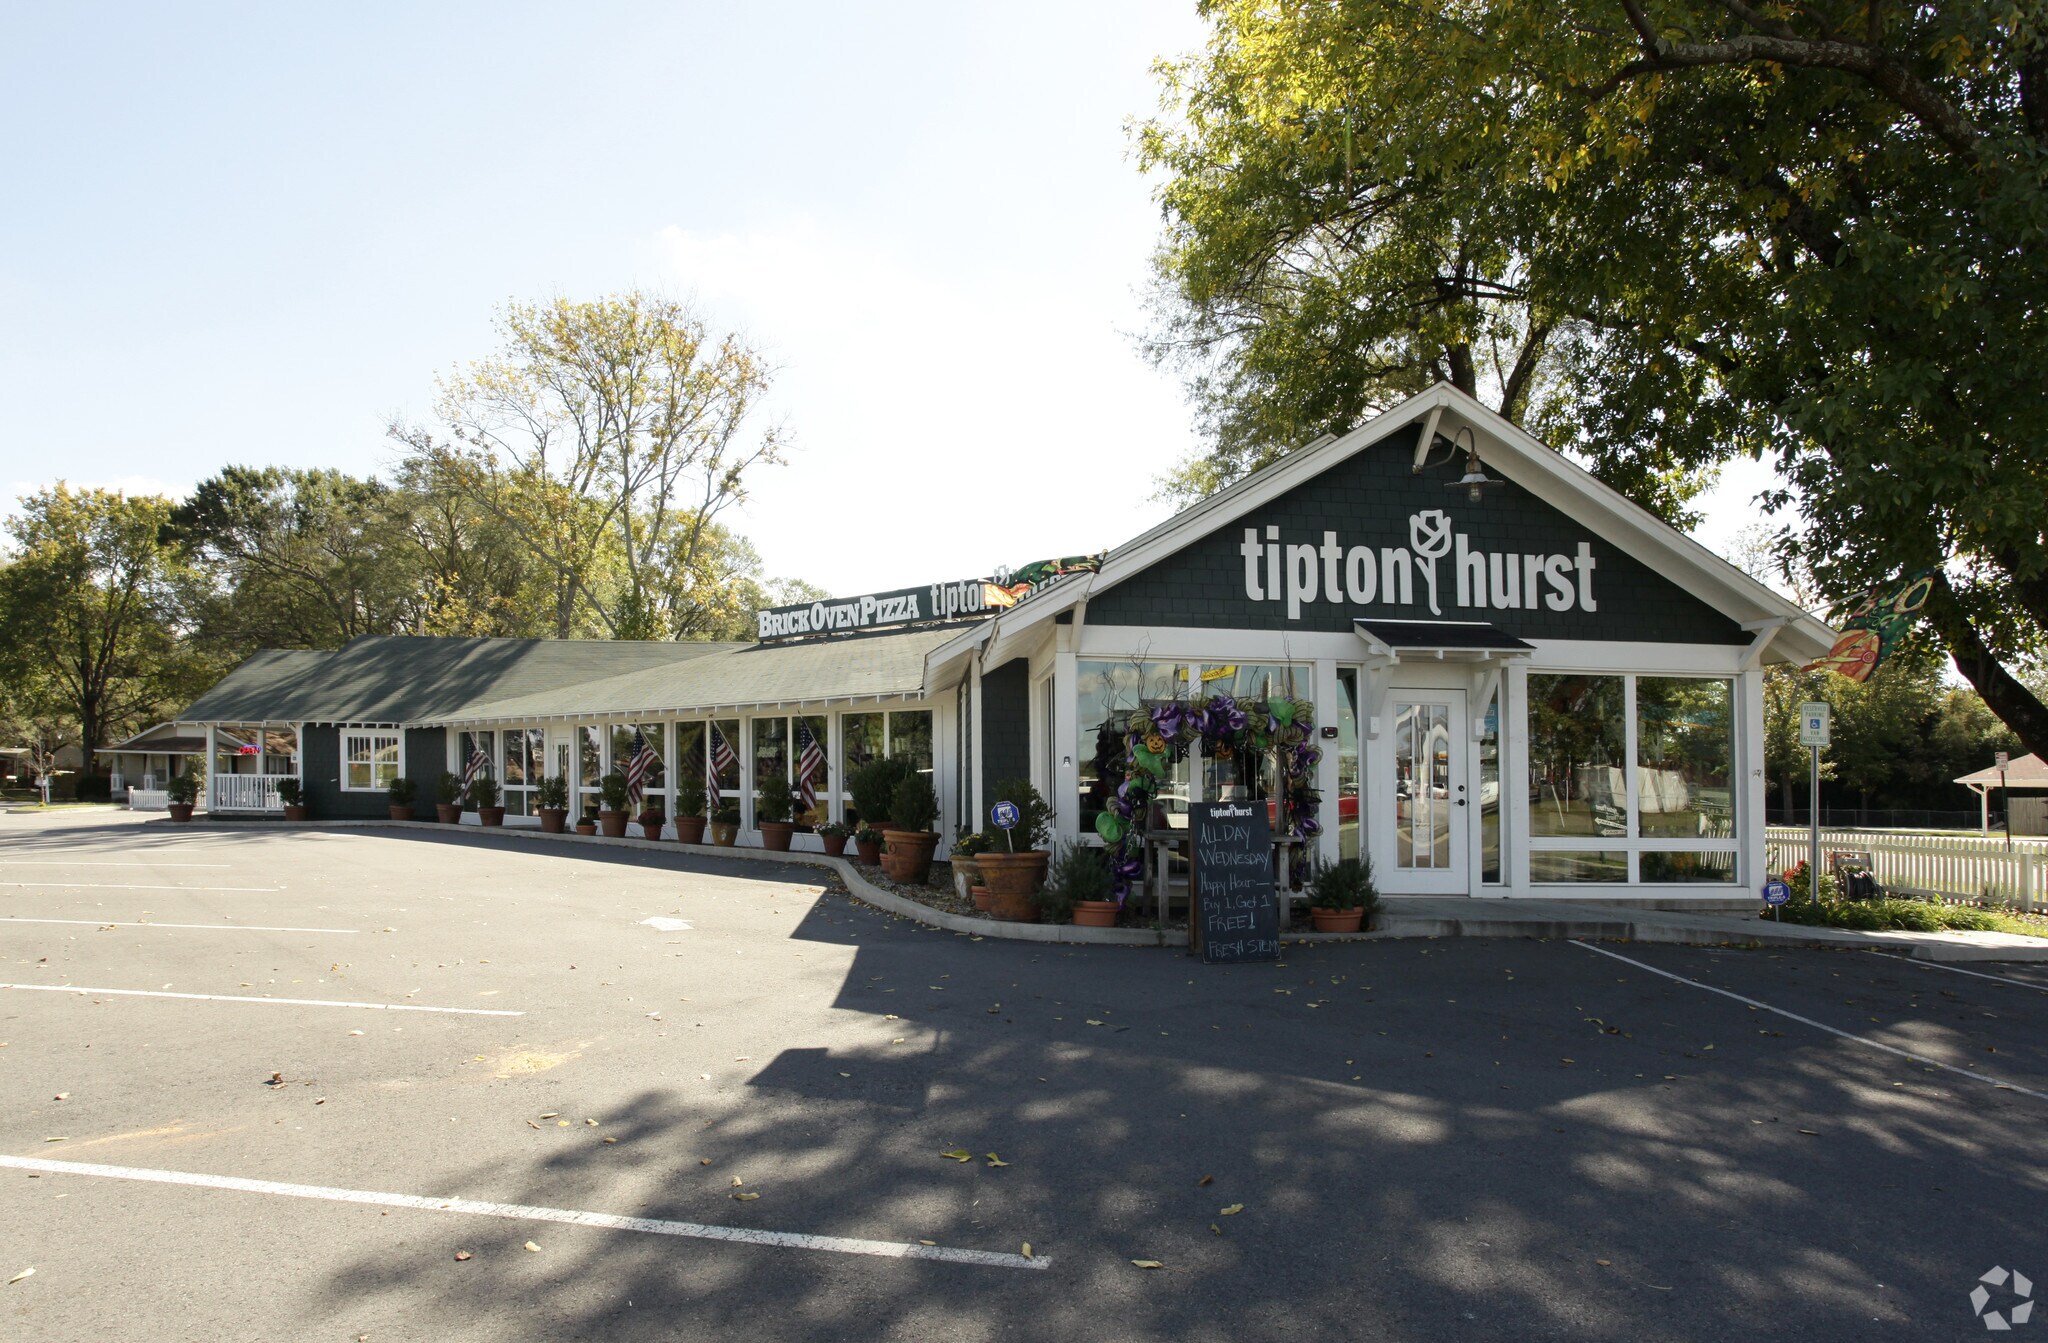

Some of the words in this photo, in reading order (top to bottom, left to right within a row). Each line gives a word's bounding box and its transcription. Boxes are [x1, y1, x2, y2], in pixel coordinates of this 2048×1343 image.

[1240, 524, 1413, 620] tipton
[1455, 533, 1597, 613] hurst
[757, 609, 811, 638] BRICK
[810, 602, 861, 631] OVEN
[860, 594, 920, 626] PIZZA
[1210, 807, 1231, 819] tipton
[1234, 806, 1253, 817] hurst
[1200, 822, 1222, 845] ALL
[1223, 824, 1251, 850] DAY
[1198, 844, 1270, 872] WEDNESDAY
[1200, 871, 1226, 897] Happy
[1208, 939, 1244, 959] FRESH
